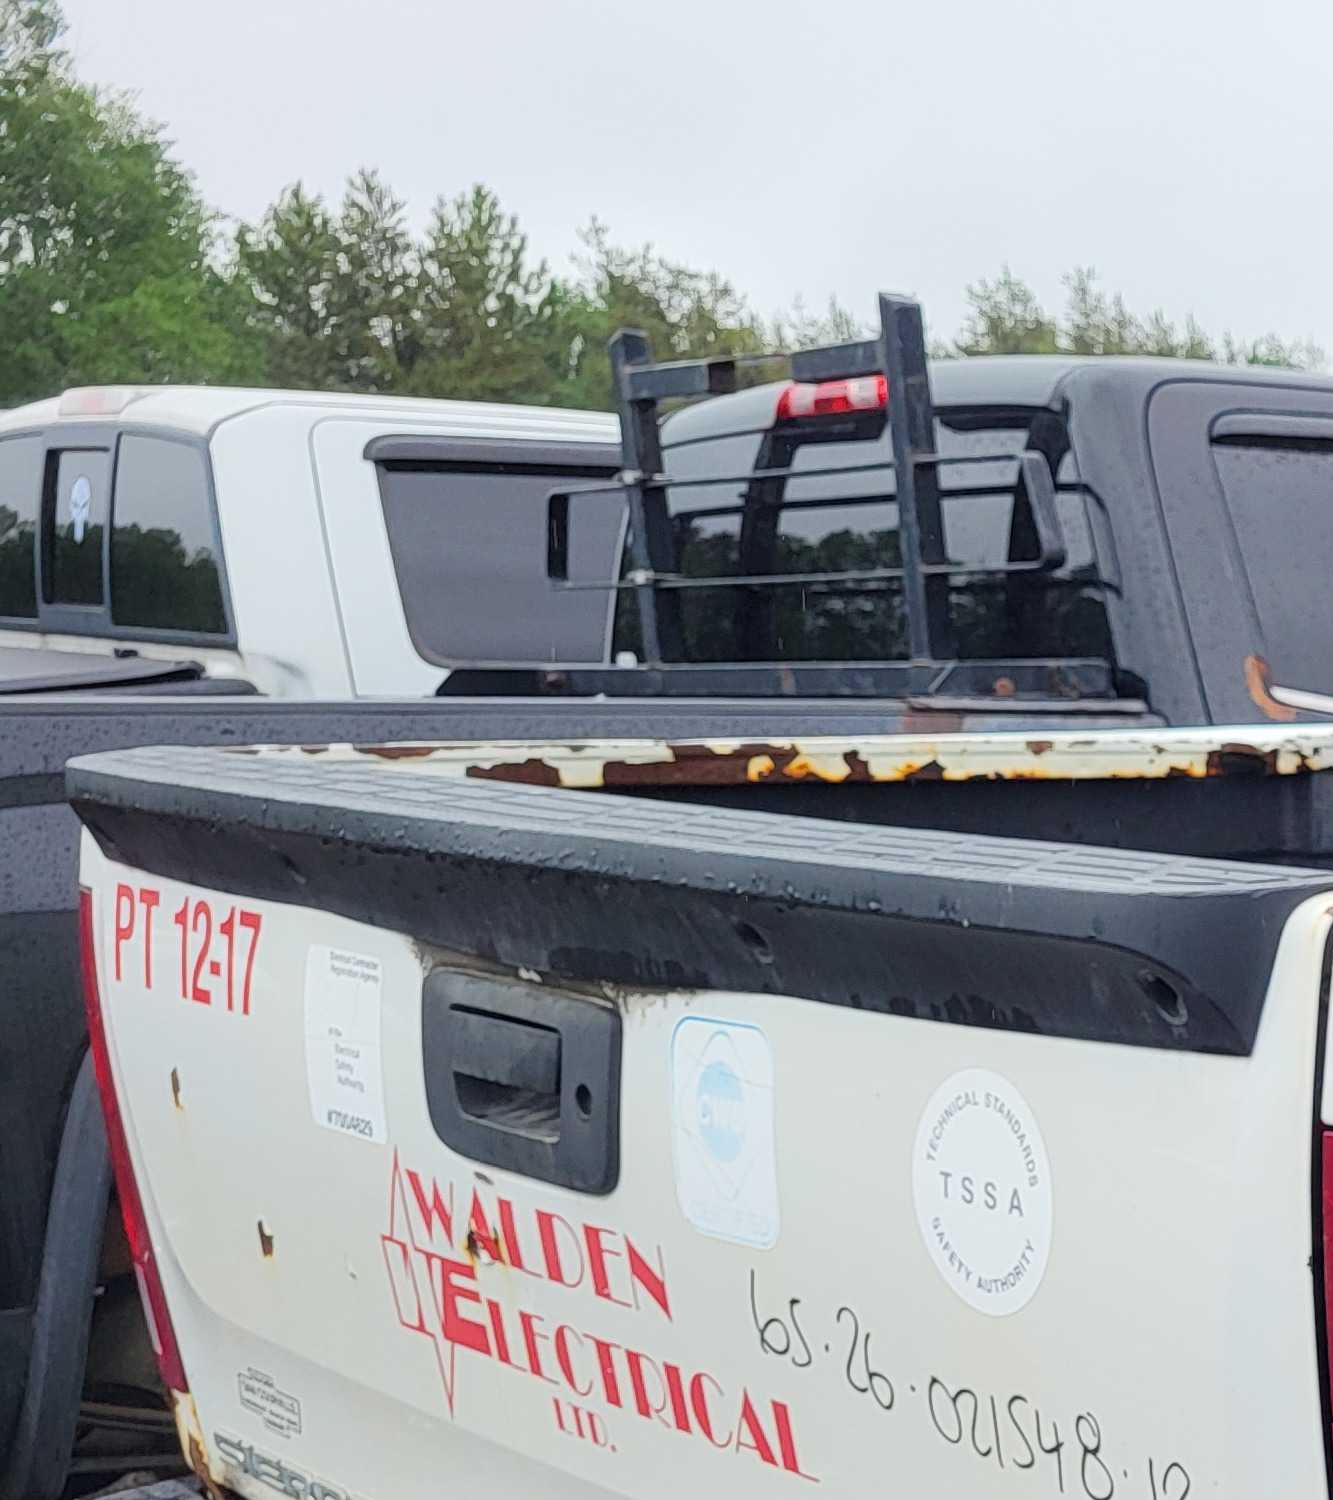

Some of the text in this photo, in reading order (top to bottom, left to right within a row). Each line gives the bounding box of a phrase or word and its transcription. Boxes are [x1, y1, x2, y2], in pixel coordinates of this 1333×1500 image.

[114, 883, 262, 1015] PT 12-17
[926, 1090, 1039, 1188] TECHNICAL STANDARDS
[938, 1170, 1024, 1217] TSSA
[405, 1167, 673, 1321] WALDEN
[932, 1217, 1035, 1293] SAFETY AUTHORITY
[427, 1252, 821, 1483] ELECTRICAL
[552, 1398, 618, 1452] LTD.
